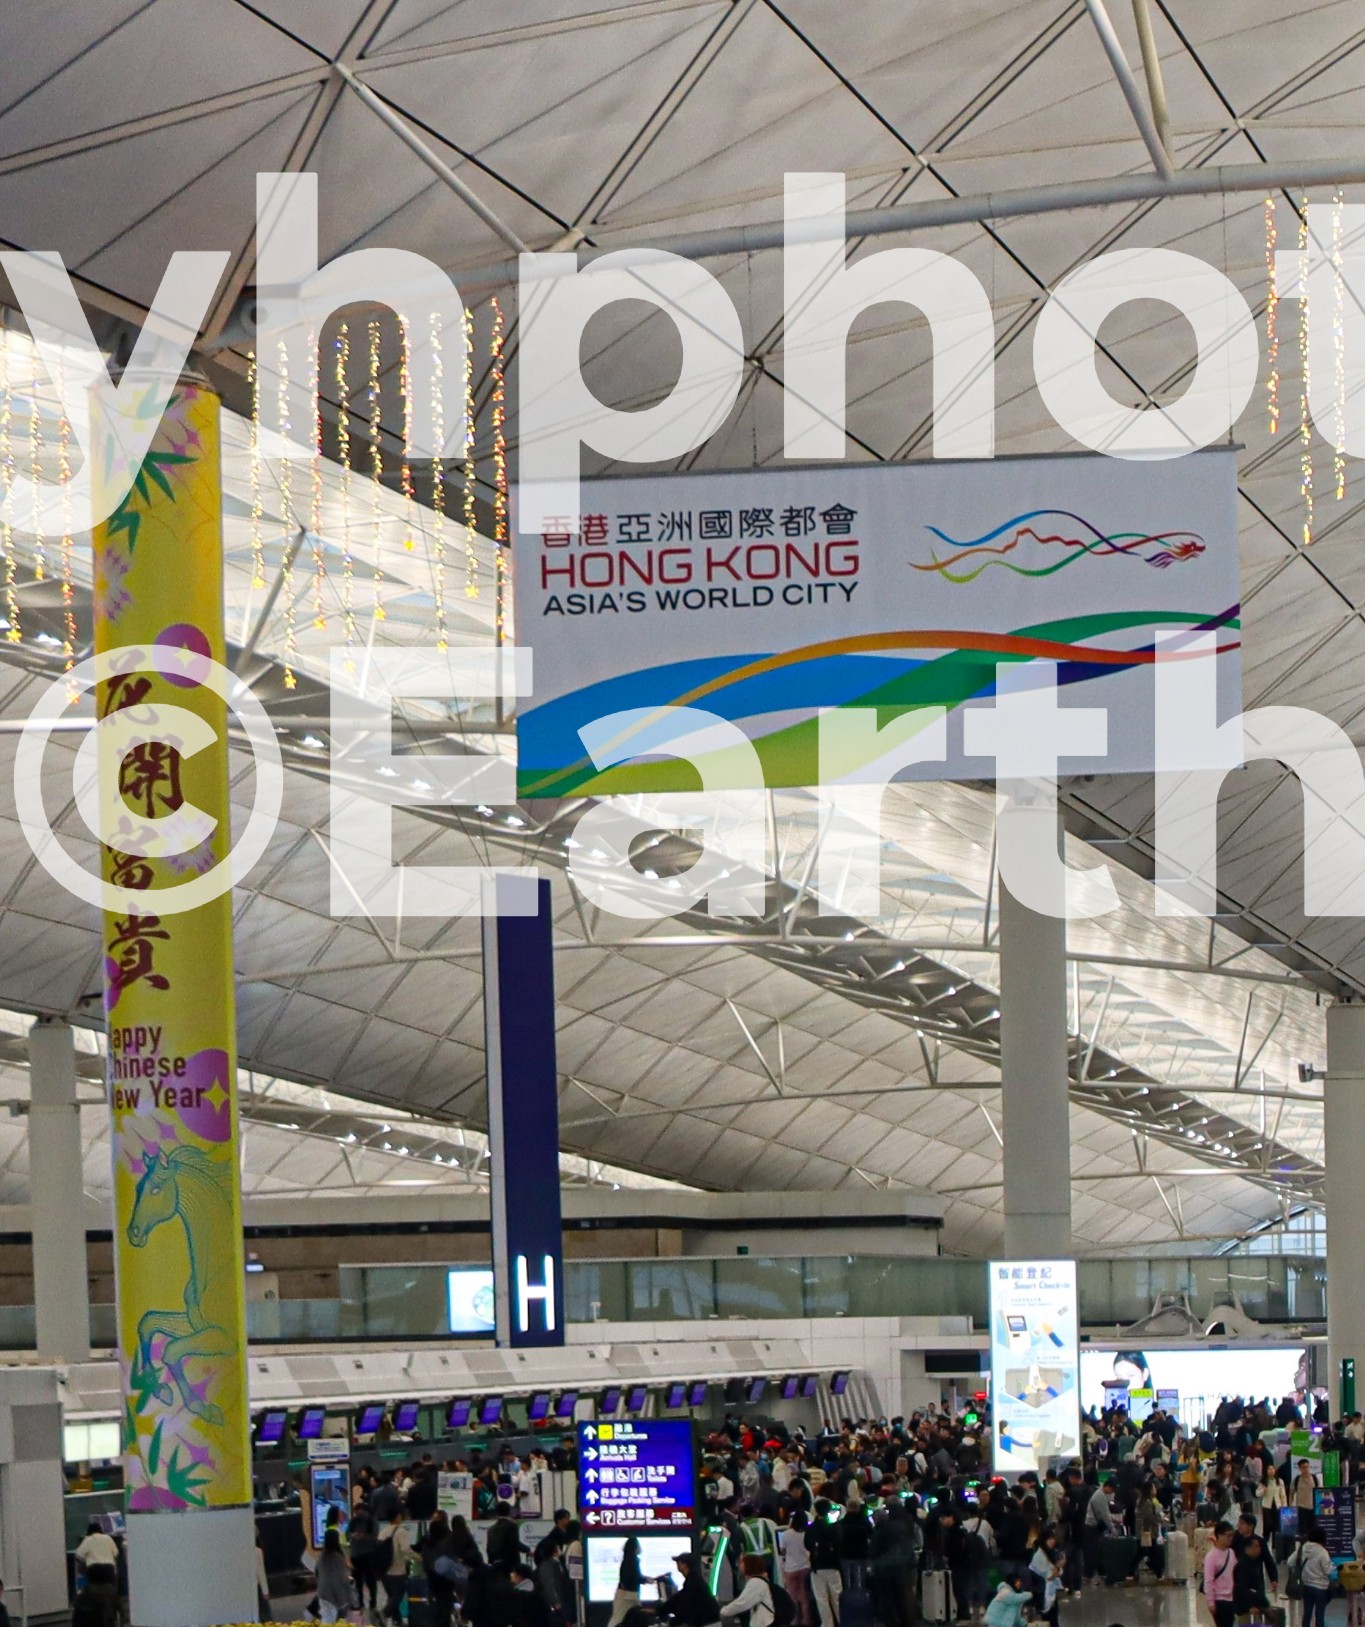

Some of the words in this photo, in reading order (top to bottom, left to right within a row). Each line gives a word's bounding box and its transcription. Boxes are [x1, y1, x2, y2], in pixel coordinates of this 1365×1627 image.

[541, 542, 692, 590] HONG
[712, 538, 860, 579] KONG
[543, 589, 647, 617] ASIA'S
[655, 585, 774, 612] WORLD
[782, 581, 860, 607] CITY
[112, 1025, 162, 1054] appy
[112, 1055, 187, 1079] hinese
[111, 1087, 140, 1110] ew
[149, 1079, 206, 1108] Year
[517, 1255, 556, 1332] H
[1308, 1437, 1320, 1453] 2
